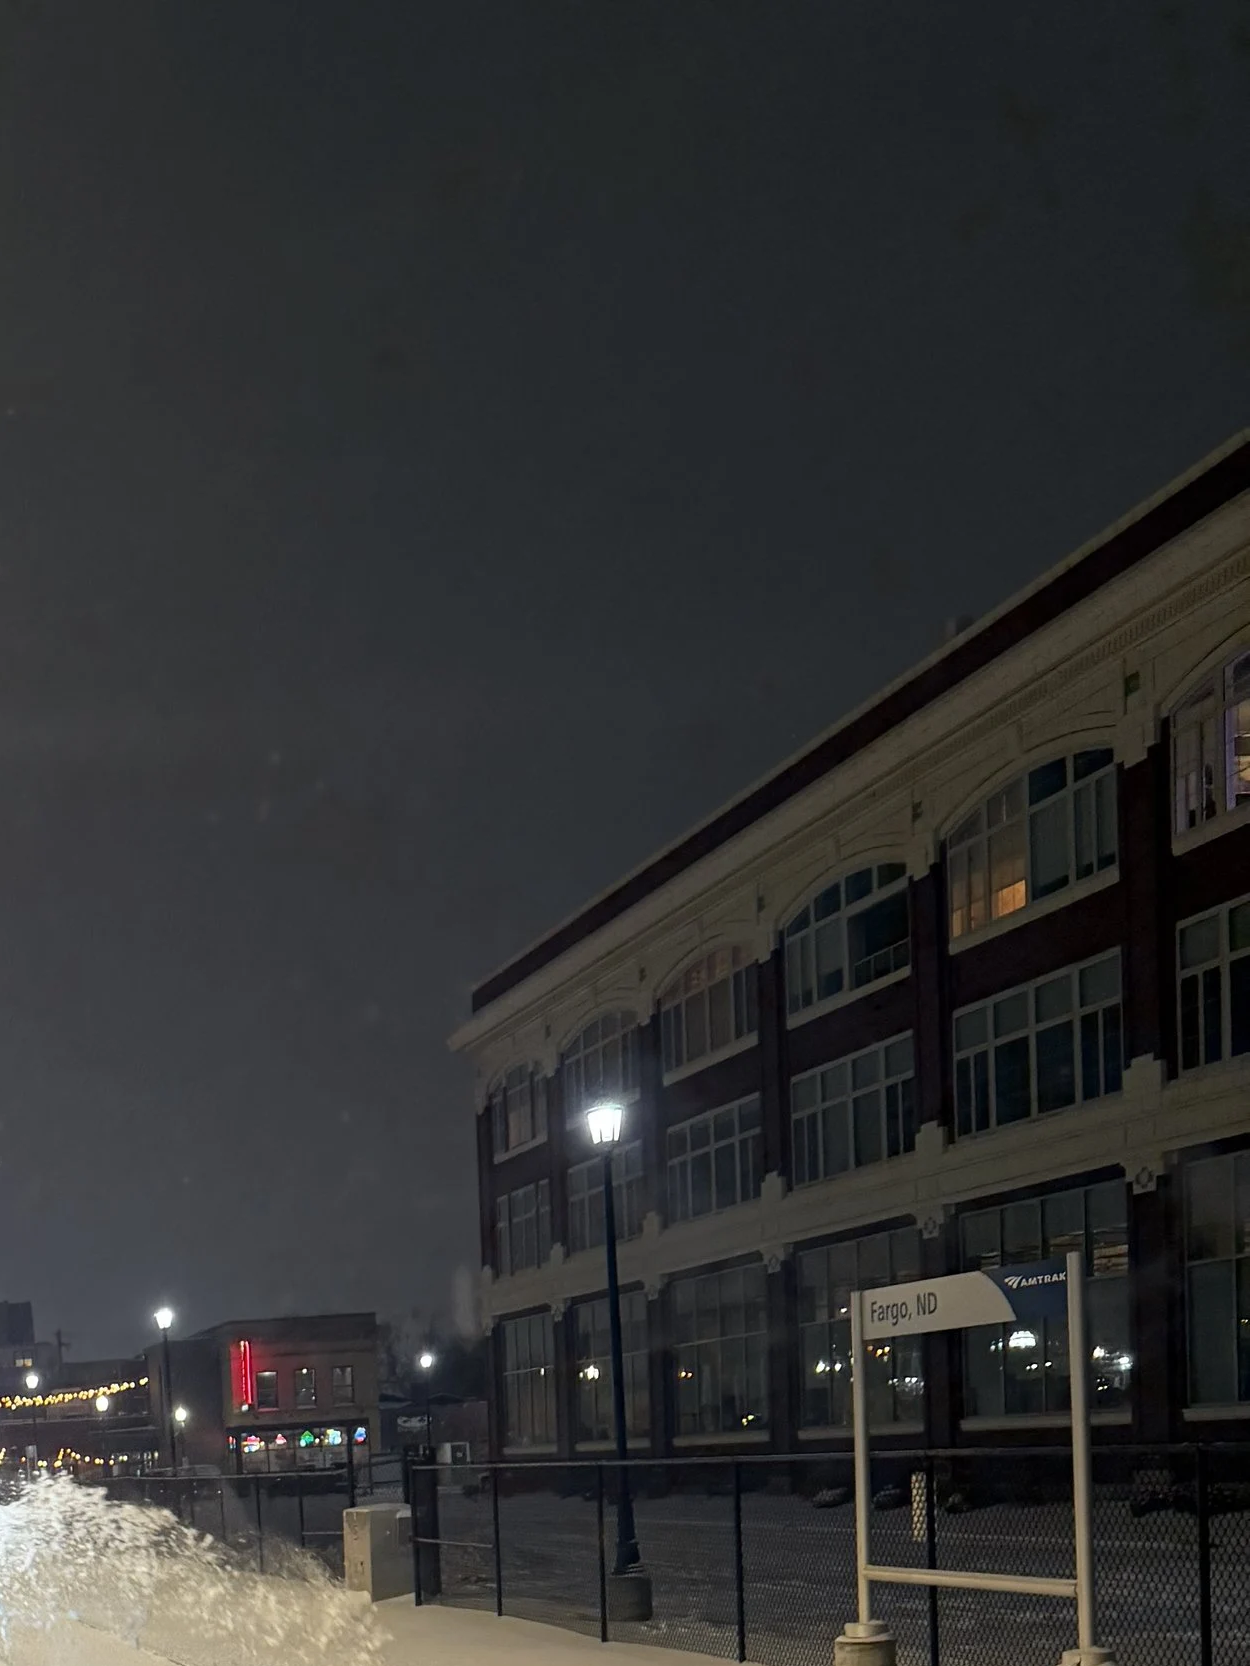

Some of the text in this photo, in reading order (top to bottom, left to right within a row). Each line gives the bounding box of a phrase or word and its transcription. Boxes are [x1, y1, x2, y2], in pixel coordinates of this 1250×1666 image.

[1020, 1271, 1066, 1287] AMTRAK
[870, 1291, 938, 1326] Fargo, ND
